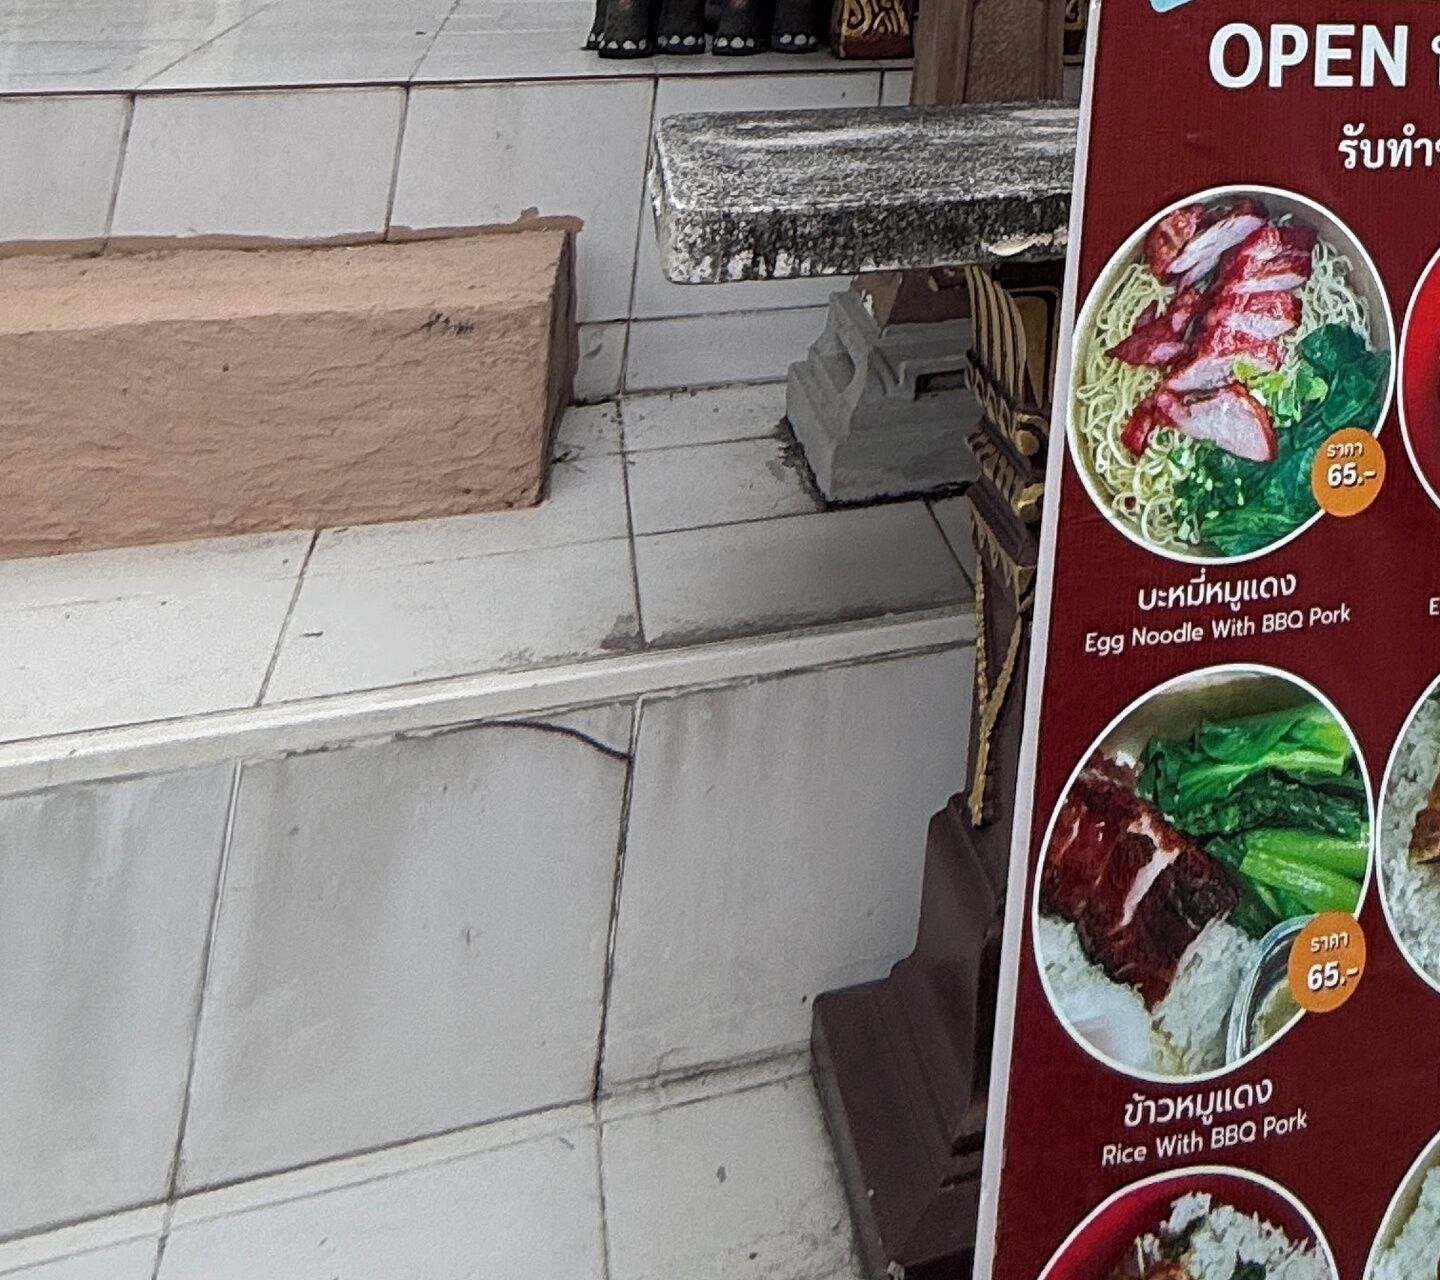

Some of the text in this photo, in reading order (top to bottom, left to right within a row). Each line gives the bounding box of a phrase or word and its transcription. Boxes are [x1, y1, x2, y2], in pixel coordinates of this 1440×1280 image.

[1207, 22, 1408, 89] OPEN
[1327, 442, 1363, 458] ราคา
[1137, 567, 1297, 612] บะหมี่หมูแดง
[1084, 602, 1351, 656] Egg Noodle With BBQ Pork
[1311, 931, 1349, 952] ราคา
[1124, 1078, 1273, 1127] ข้าวหมูแดง
[1102, 1108, 1307, 1167] Rice With BBQ Pork
